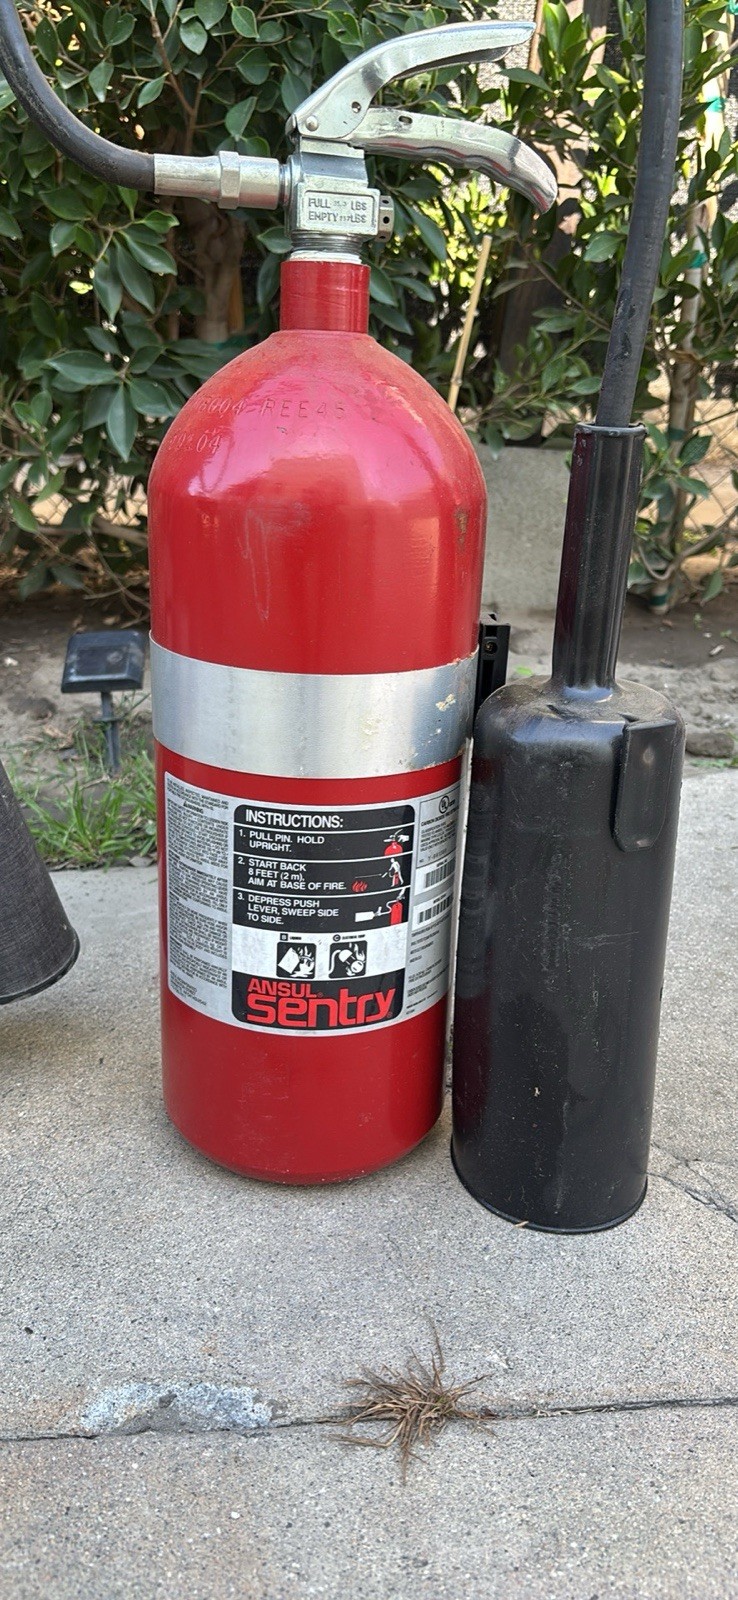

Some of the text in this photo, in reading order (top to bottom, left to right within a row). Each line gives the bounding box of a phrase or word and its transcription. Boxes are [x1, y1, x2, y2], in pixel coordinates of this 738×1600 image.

[308, 197, 331, 209] FULL
[351, 200, 367, 211] LBS
[308, 211, 339, 222] EMPTY
[351, 213, 367, 223] LBS
[245, 809, 344, 829] INSTRUCTIONS:
[239, 829, 325, 845] 1. PULL PIN. HOLD
[249, 840, 292, 853] UPRIGHT.
[237, 856, 307, 872] 2. START BACK
[248, 867, 254, 876] 8
[255, 869, 279, 879] FEET
[280, 871, 289, 881] (2
[248, 877, 347, 891] AIM AT BASE OF FIRE.
[237, 892, 320, 908] 3. DEPRESS PUSH
[247, 902, 339, 917] LEVER, SWEEP SIDE
[247, 912, 284, 925] TO SIDE.
[247, 978, 317, 998] ANSUL
[246, 987, 396, 1028] sentry
